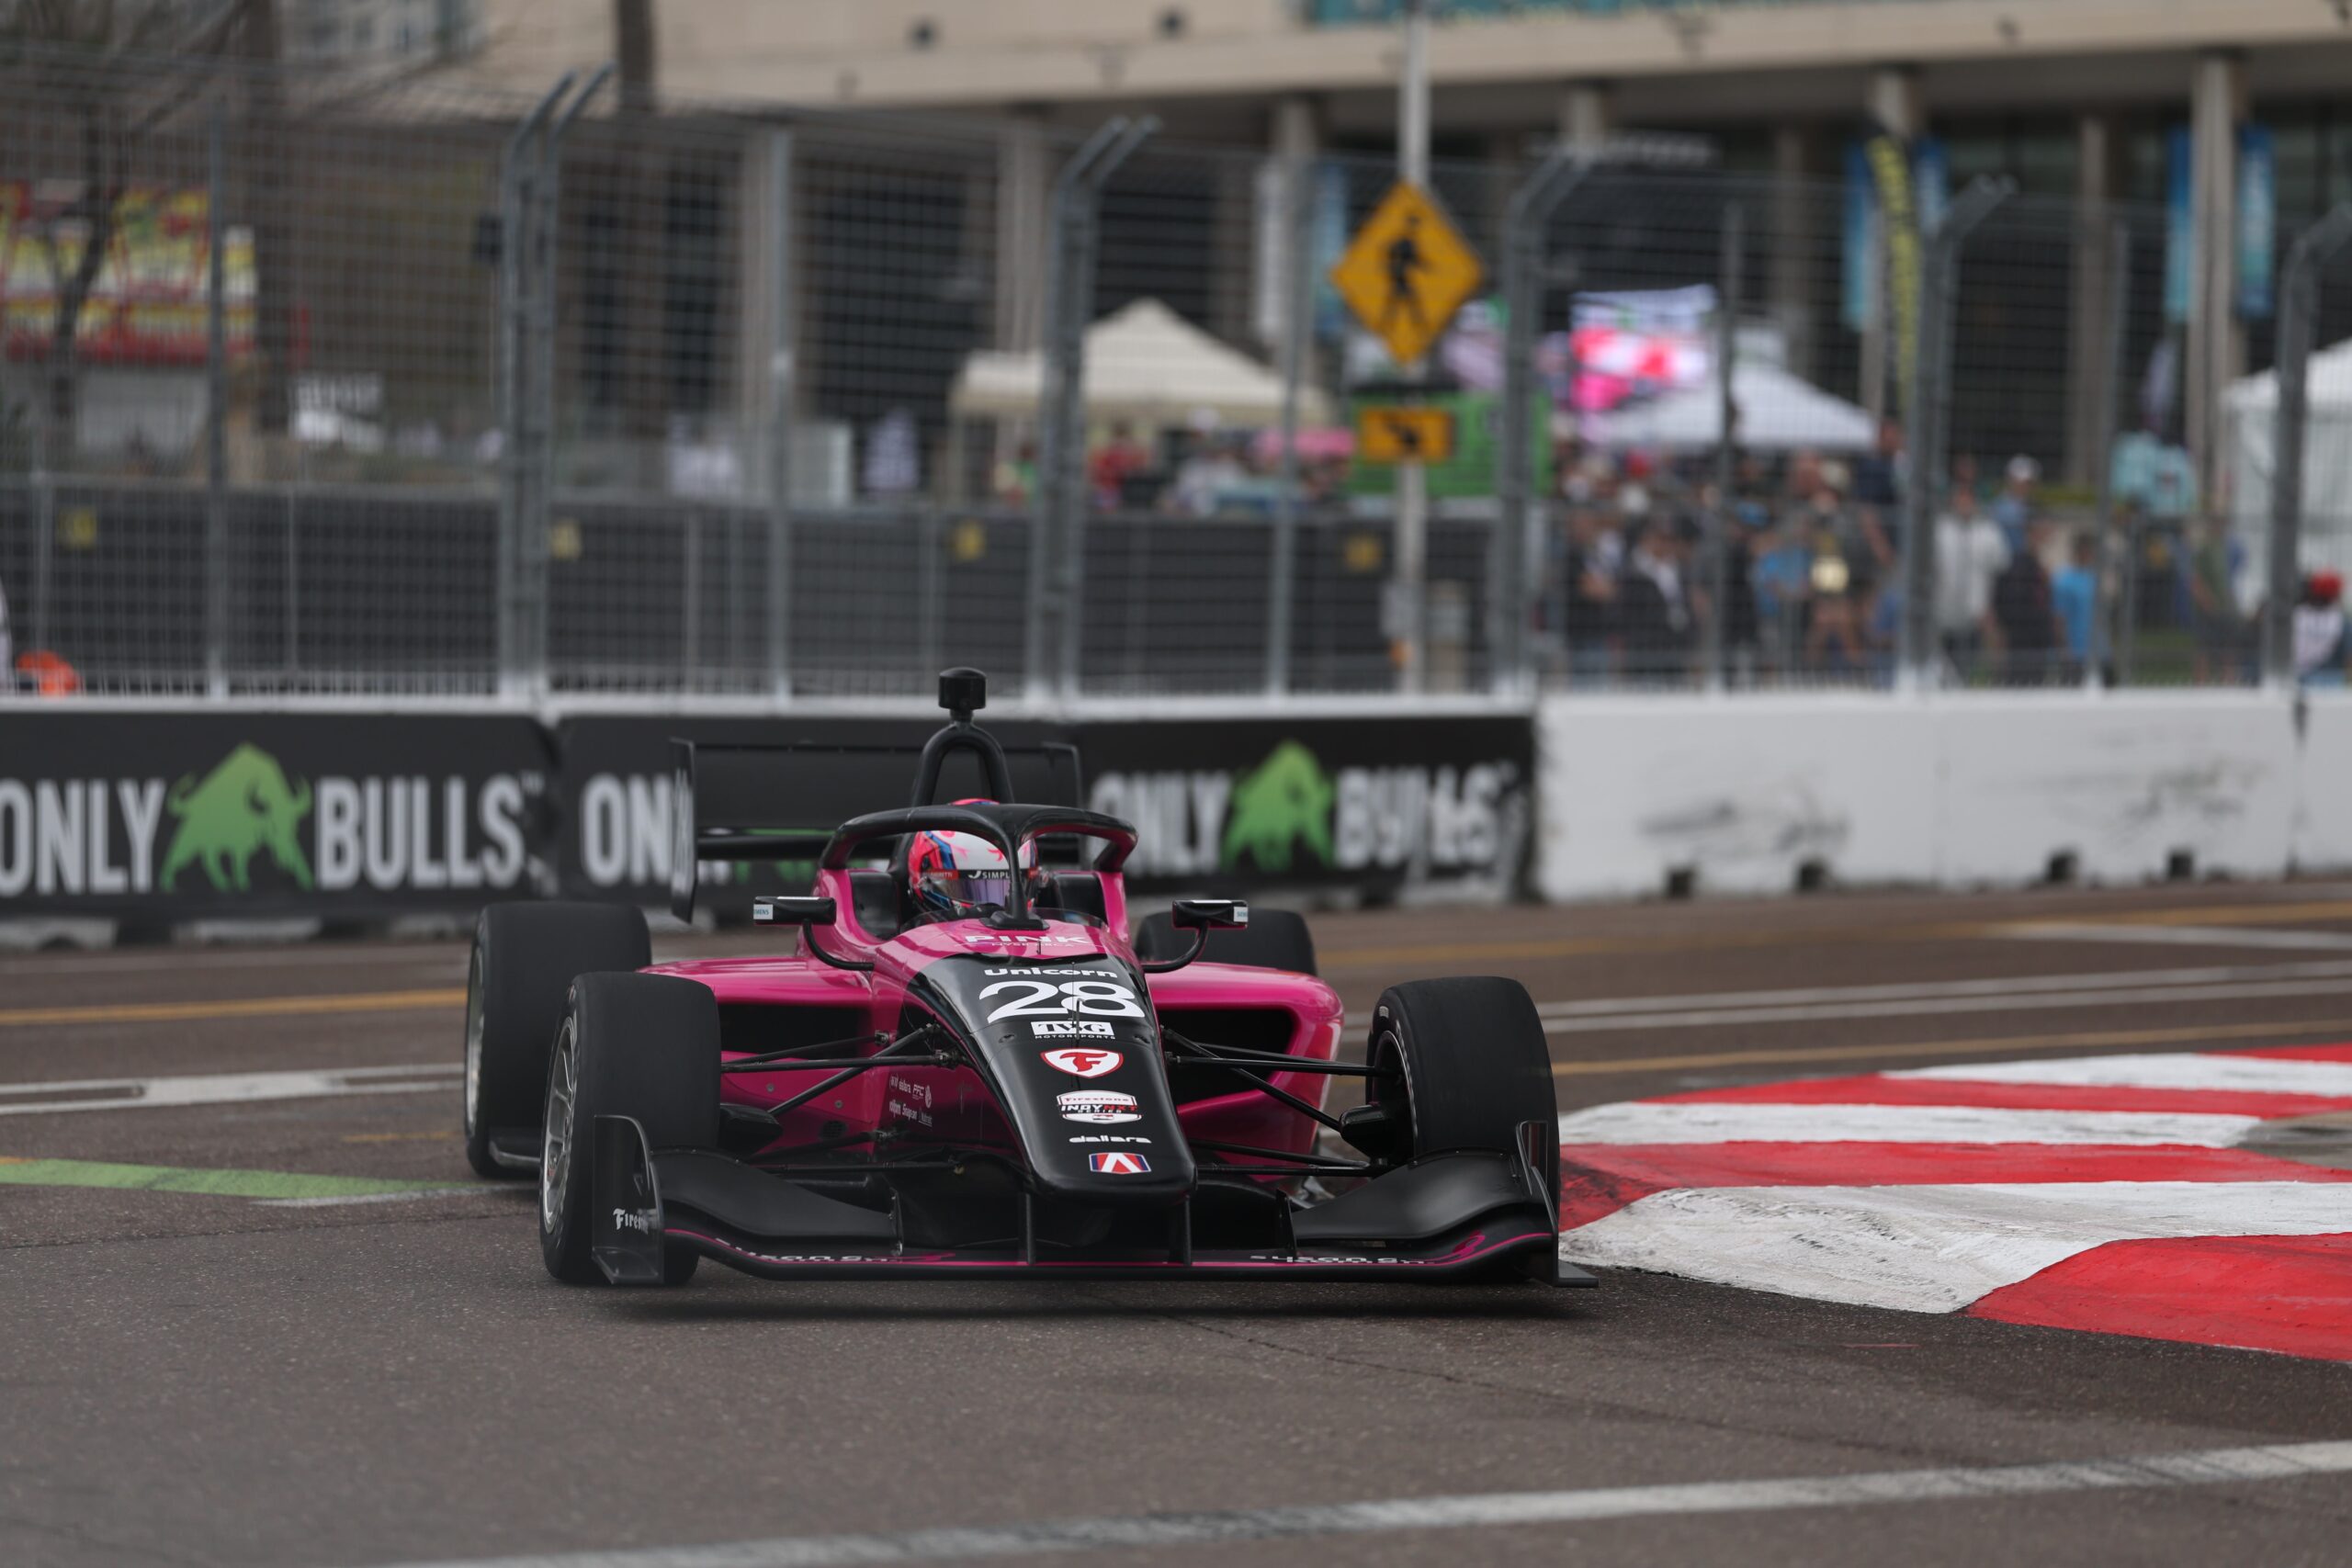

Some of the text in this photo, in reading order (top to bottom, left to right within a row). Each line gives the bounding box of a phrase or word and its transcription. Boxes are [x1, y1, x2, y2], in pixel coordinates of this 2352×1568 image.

[0, 773, 526, 897] ONLY BULLS
[965, 935, 1091, 944] PINK
[978, 980, 1146, 1024] 28
[1069, 1134, 1152, 1144] dallara
